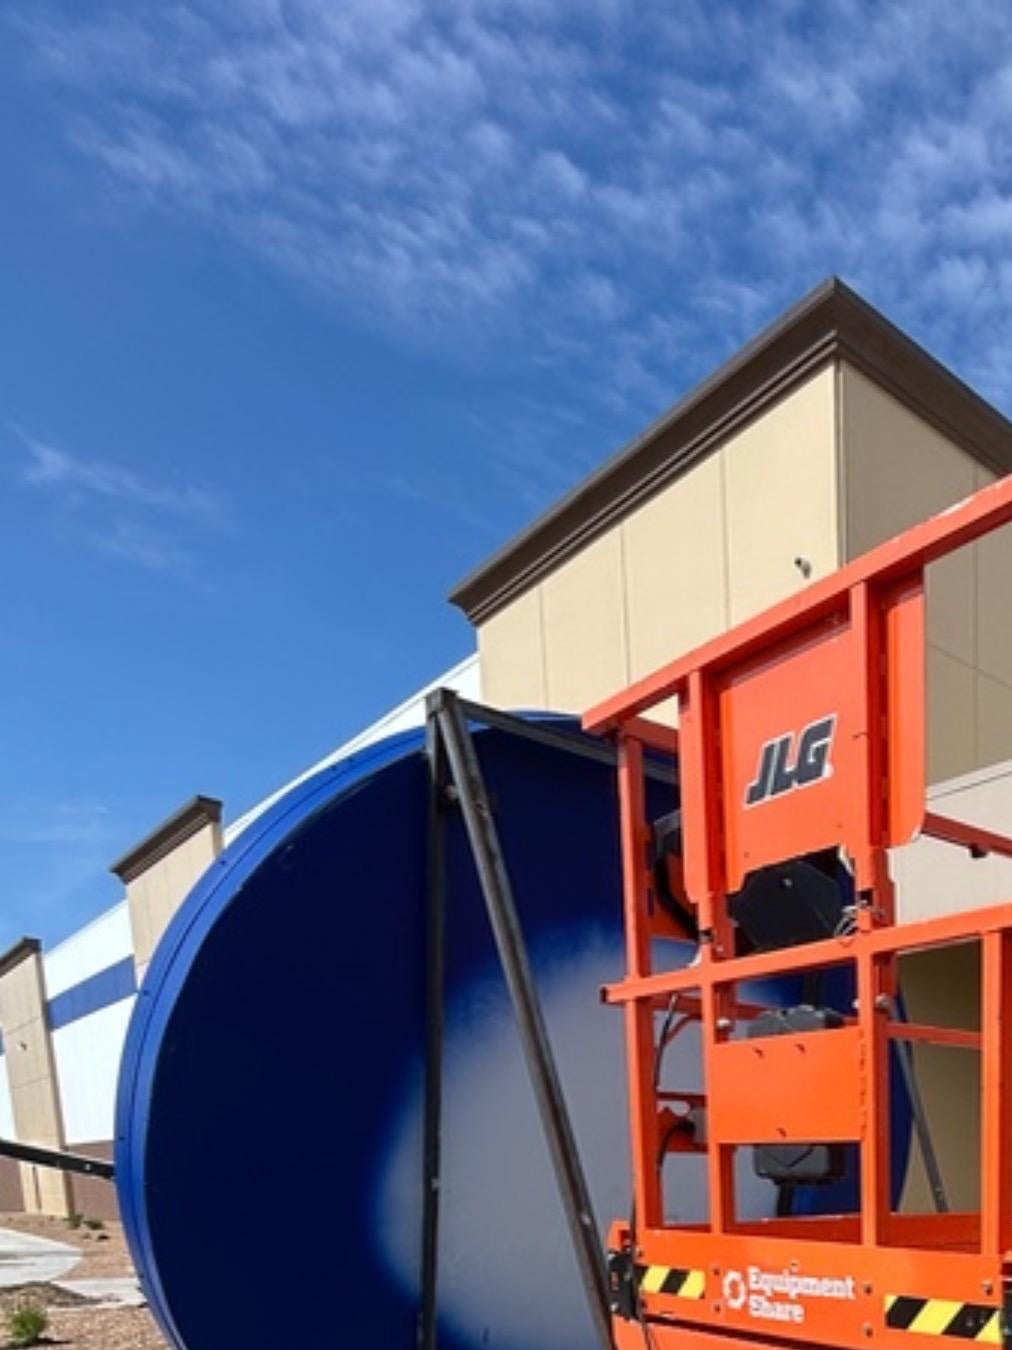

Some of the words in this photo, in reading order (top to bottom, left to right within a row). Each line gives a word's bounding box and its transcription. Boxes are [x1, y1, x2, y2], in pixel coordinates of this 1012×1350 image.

[743, 713, 837, 808] JLG
[747, 1265, 856, 1300] Equipment
[748, 1294, 805, 1324] Share
